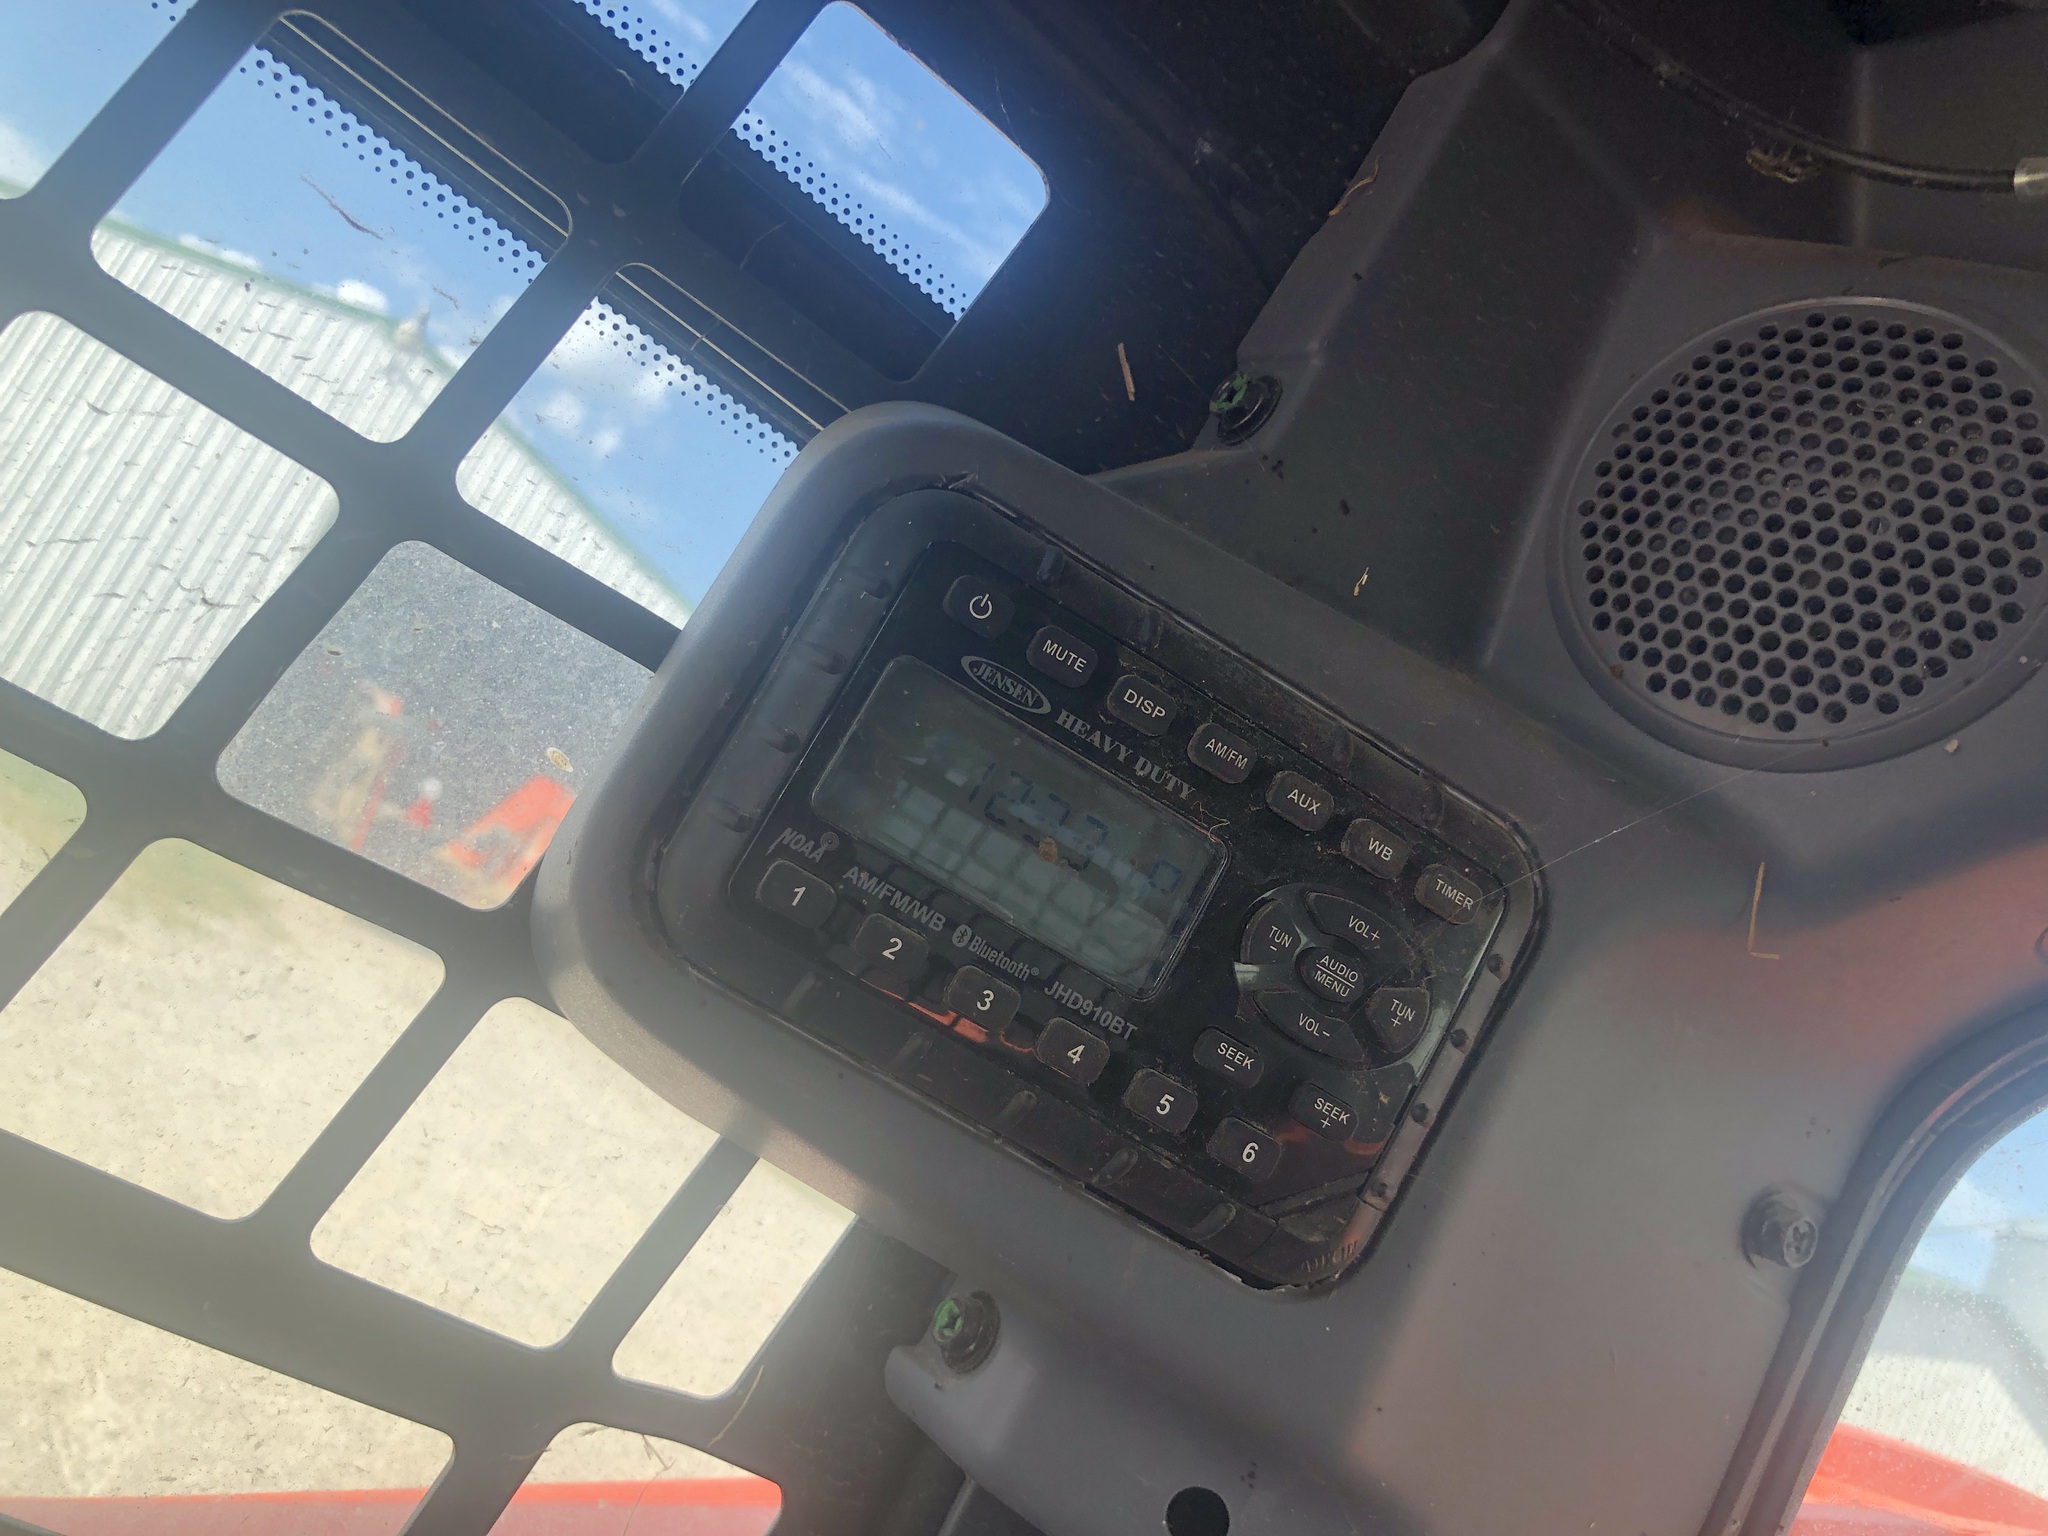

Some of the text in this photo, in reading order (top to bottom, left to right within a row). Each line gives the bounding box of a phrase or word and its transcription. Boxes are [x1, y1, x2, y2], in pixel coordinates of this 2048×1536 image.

[1043, 639, 1087, 673] MUTE
[972, 662, 1038, 708] JENSEN
[1123, 688, 1166, 719] DISP
[1055, 709, 1196, 800] HEAVY DUTY
[1204, 738, 1249, 770] AM/FM
[1287, 788, 1322, 815] AUX
[766, 827, 829, 862] NOAA
[1368, 837, 1394, 862] WB
[792, 886, 807, 906] 1
[842, 866, 947, 931] AM/FM/WB
[1435, 878, 1474, 910] TIMER
[882, 937, 903, 960] 2
[1268, 925, 1293, 948] TUN
[1319, 954, 1359, 983] AUDIO
[1314, 970, 1350, 998] MENU
[976, 989, 995, 1011] 3
[1044, 981, 1139, 1041] JHD910BT
[1390, 998, 1416, 1022] TUN
[1066, 1044, 1086, 1064] 4
[1217, 1042, 1255, 1070] SEEK
[1155, 1093, 1175, 1115] 5
[1314, 1097, 1351, 1125] SEEK
[1241, 1142, 1259, 1162] 6
